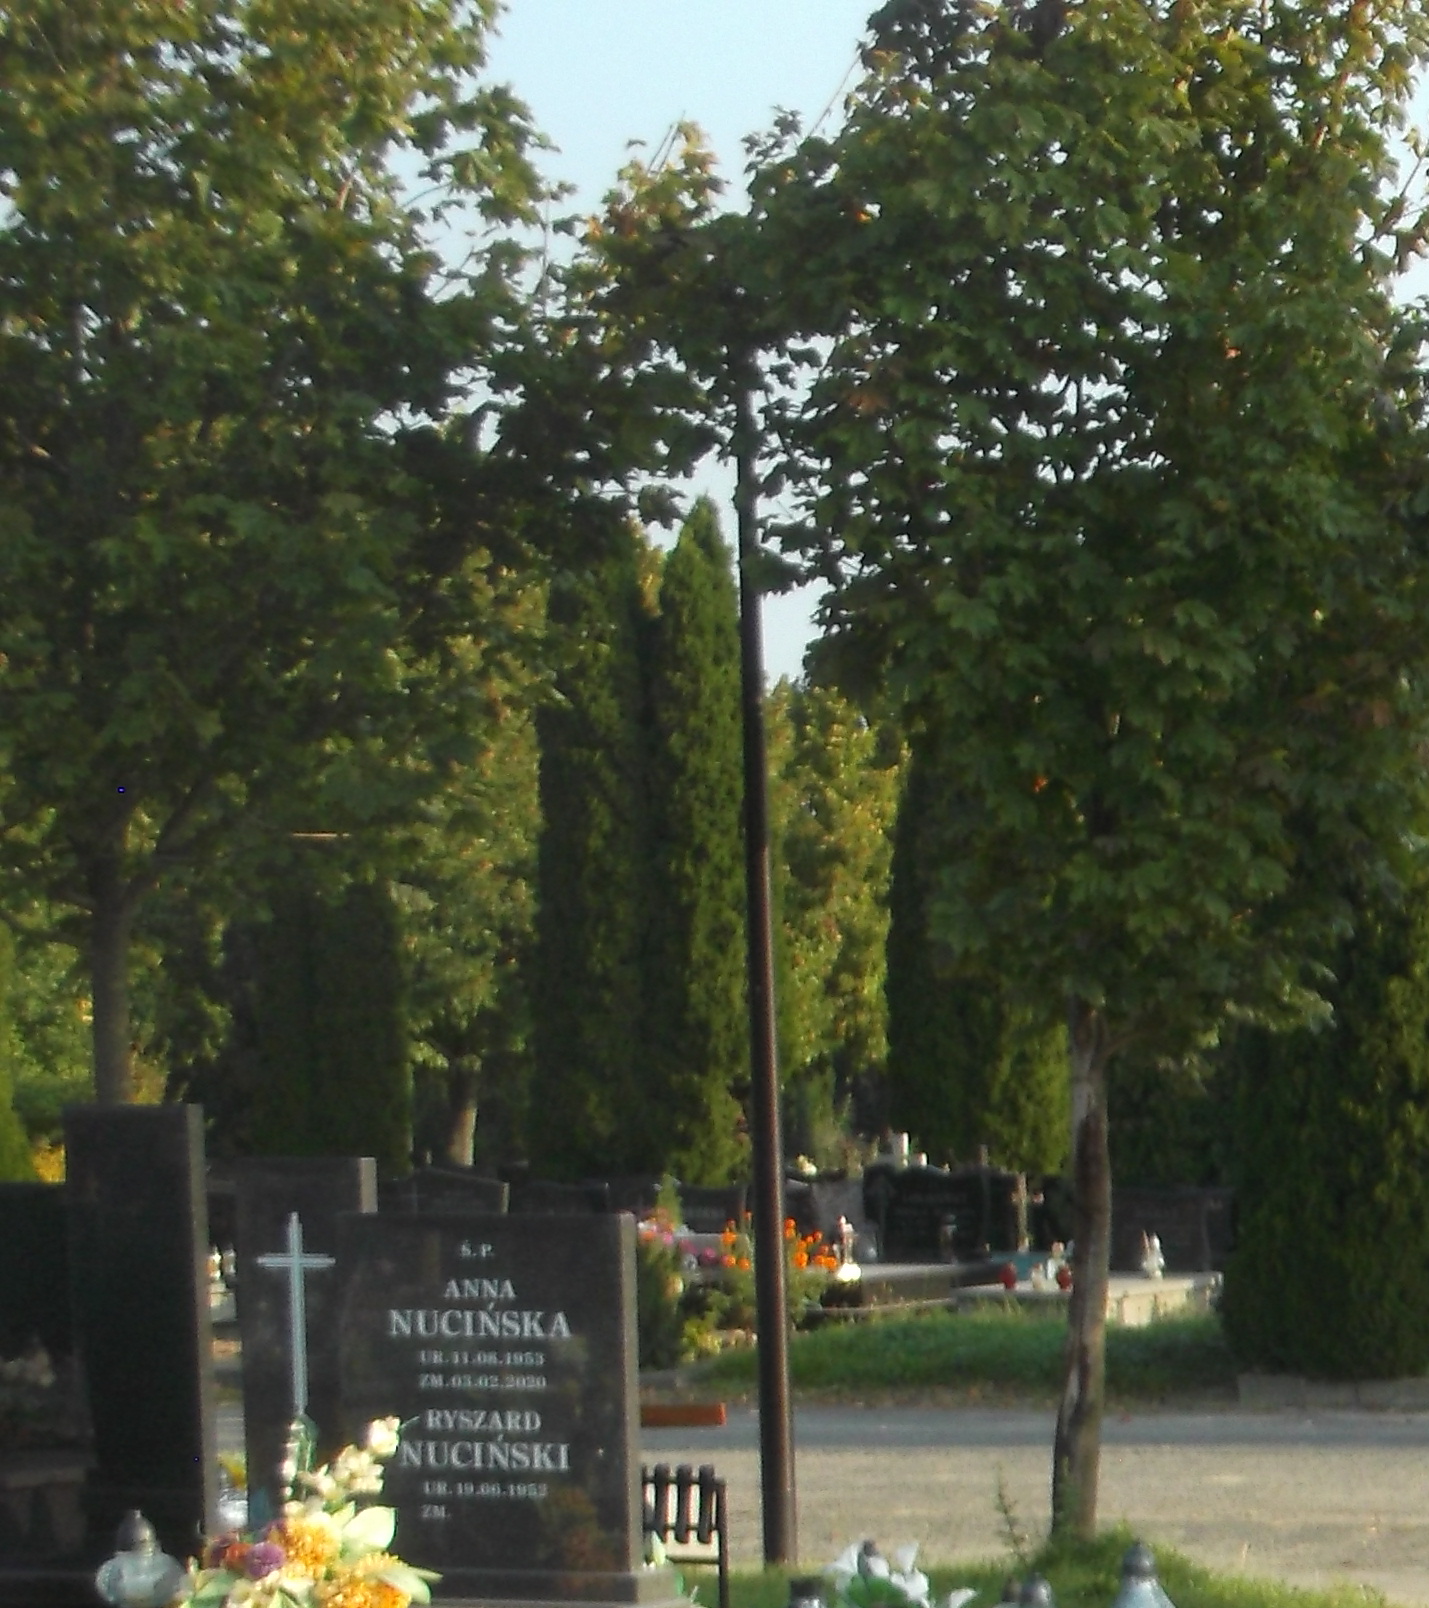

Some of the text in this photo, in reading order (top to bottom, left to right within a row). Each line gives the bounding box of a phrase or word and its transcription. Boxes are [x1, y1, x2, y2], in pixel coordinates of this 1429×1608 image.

[443, 1278, 518, 1300] ANNA
[388, 1302, 573, 1339] NUCIŃSKA
[425, 1408, 542, 1432] RYSZARD
[400, 1433, 571, 1470] NUCIŃSKI
